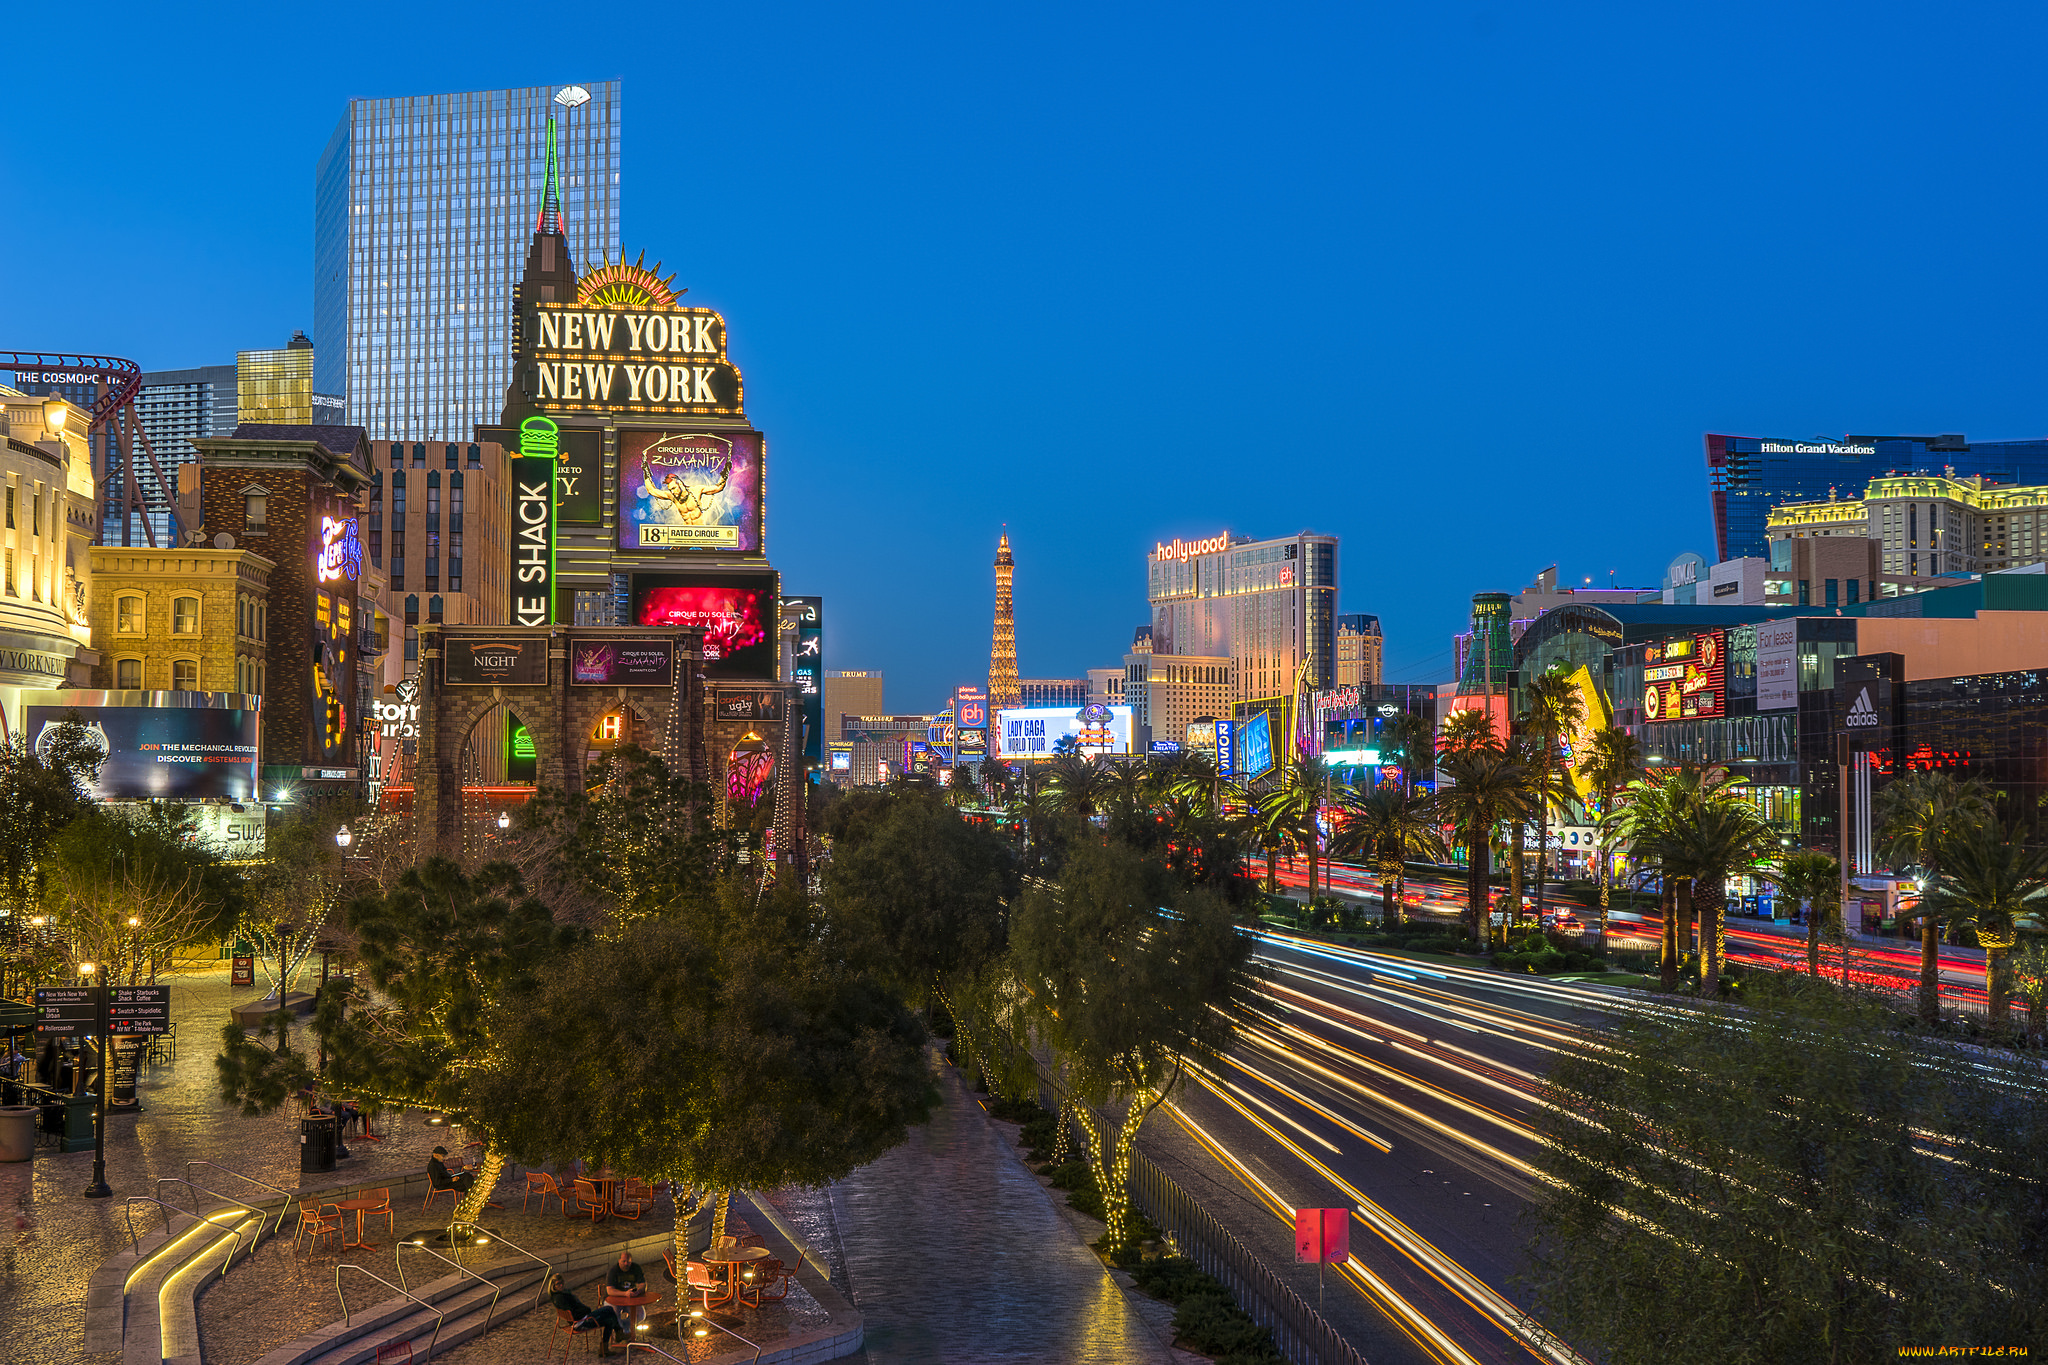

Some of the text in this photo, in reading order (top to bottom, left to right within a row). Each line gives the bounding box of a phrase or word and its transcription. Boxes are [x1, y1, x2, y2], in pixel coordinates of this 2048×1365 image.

[537, 312, 717, 353] NEW YORK
[15, 372, 39, 382] THE
[537, 362, 717, 403] NEW YORK
[1761, 443, 1875, 454] Hilton Grand Vacations
[651, 454, 726, 473] ZUMANITY
[518, 481, 547, 584] SHACK
[643, 528, 667, 542] 18+
[695, 530, 719, 538] CIRQUE
[1157, 530, 1228, 564] hollywood
[668, 611, 697, 619] CIRQUE
[1760, 630, 1793, 648] For lease
[1665, 640, 1694, 658] SUBWAY
[9, 651, 43, 672] YORK
[474, 656, 517, 666] NIGHT
[618, 656, 668, 669] ZUMANITY
[720, 695, 752, 704] coyote
[959, 693, 987, 701] hollywood
[729, 700, 752, 711] ugly
[1846, 712, 1878, 727] adidas
[1008, 720, 1045, 737] LADY GAGA
[1008, 738, 1046, 752] WORLD TOUR
[1726, 716, 1788, 762] RESORTS
[1218, 723, 1230, 770] ROSS
[157, 755, 202, 763] DISCOVER
